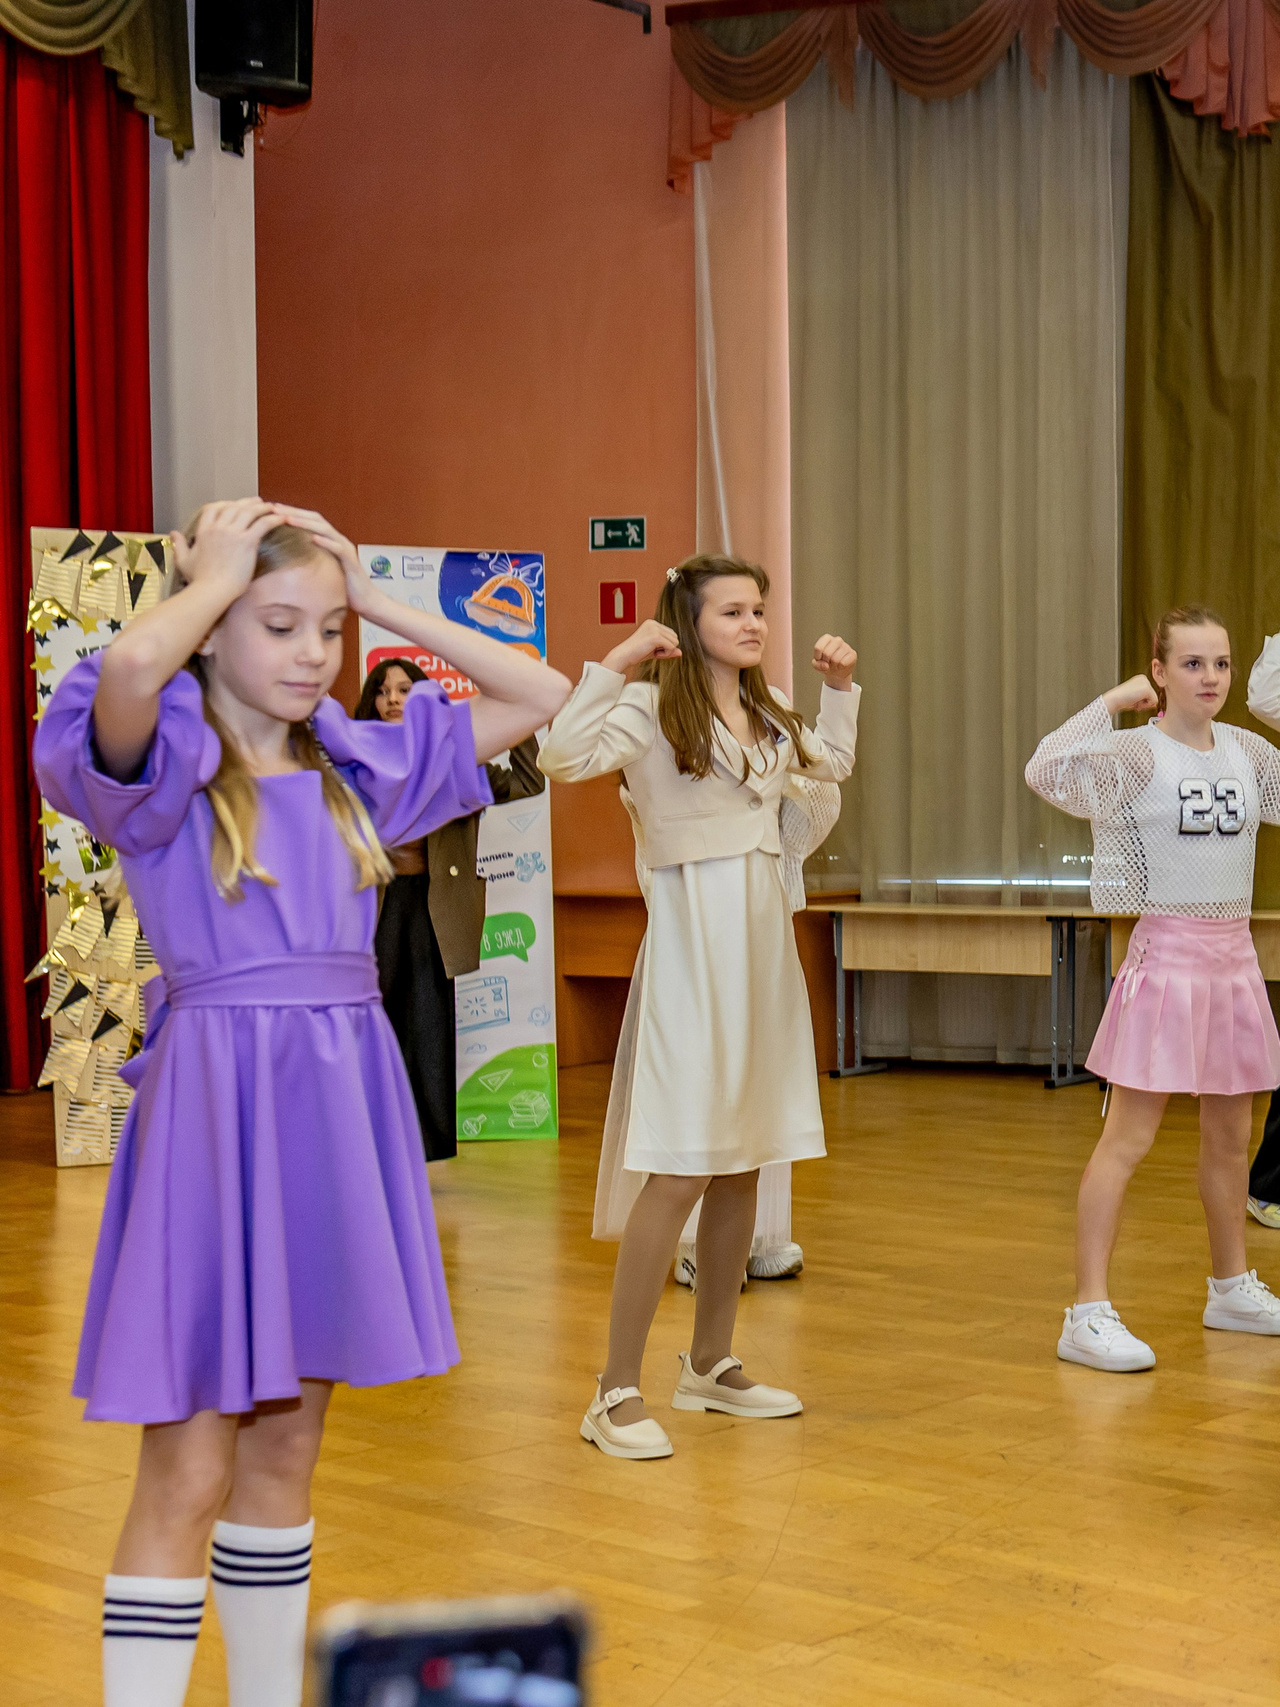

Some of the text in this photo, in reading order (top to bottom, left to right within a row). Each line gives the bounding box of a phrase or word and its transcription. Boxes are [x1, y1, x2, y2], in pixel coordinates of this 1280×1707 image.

[433, 677, 480, 693] ОН
[1178, 778, 1246, 836] 23
[477, 852, 513, 862] чились
[486, 871, 515, 882] фоне
